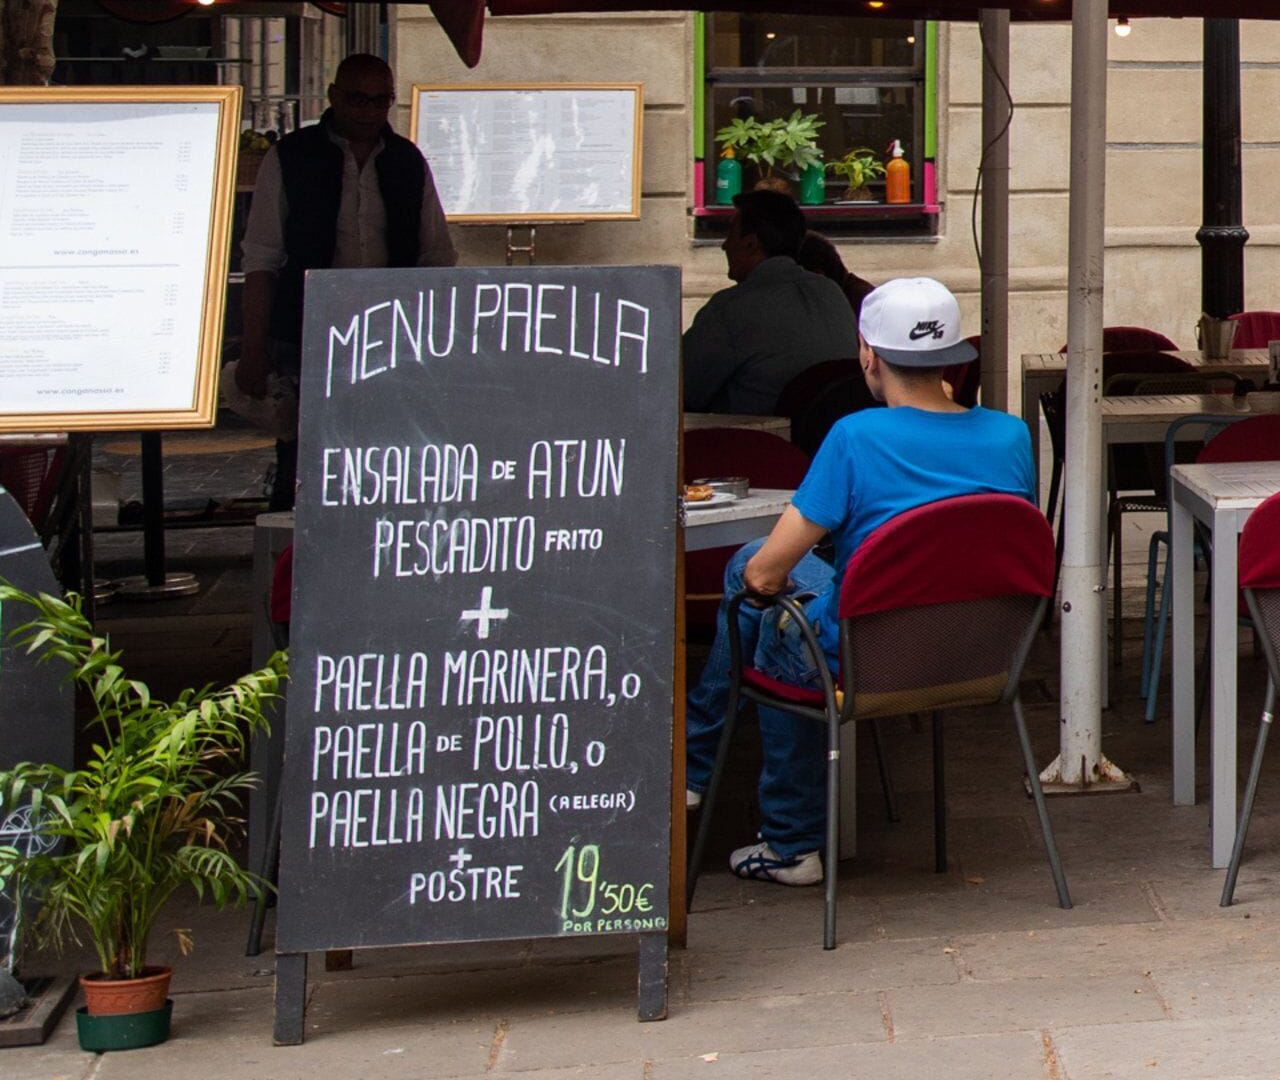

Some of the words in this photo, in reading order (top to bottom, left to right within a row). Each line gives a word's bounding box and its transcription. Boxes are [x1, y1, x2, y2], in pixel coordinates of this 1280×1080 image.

[326, 286, 457, 398] MENU
[472, 282, 650, 374] PAELLA
[916, 320, 940, 331] NIKE
[321, 443, 479, 507] ENSALADA
[491, 460, 517, 481] DE
[528, 438, 627, 500] ATUN
[372, 515, 536, 579] PESCADITO
[544, 528, 604, 553] FRITO
[314, 651, 429, 713] PAELLA
[312, 720, 427, 782] PAELLA
[435, 735, 463, 753] DE
[309, 787, 424, 850] PAELLA
[434, 780, 540, 841] NEGRA
[409, 864, 524, 905] POSTRE
